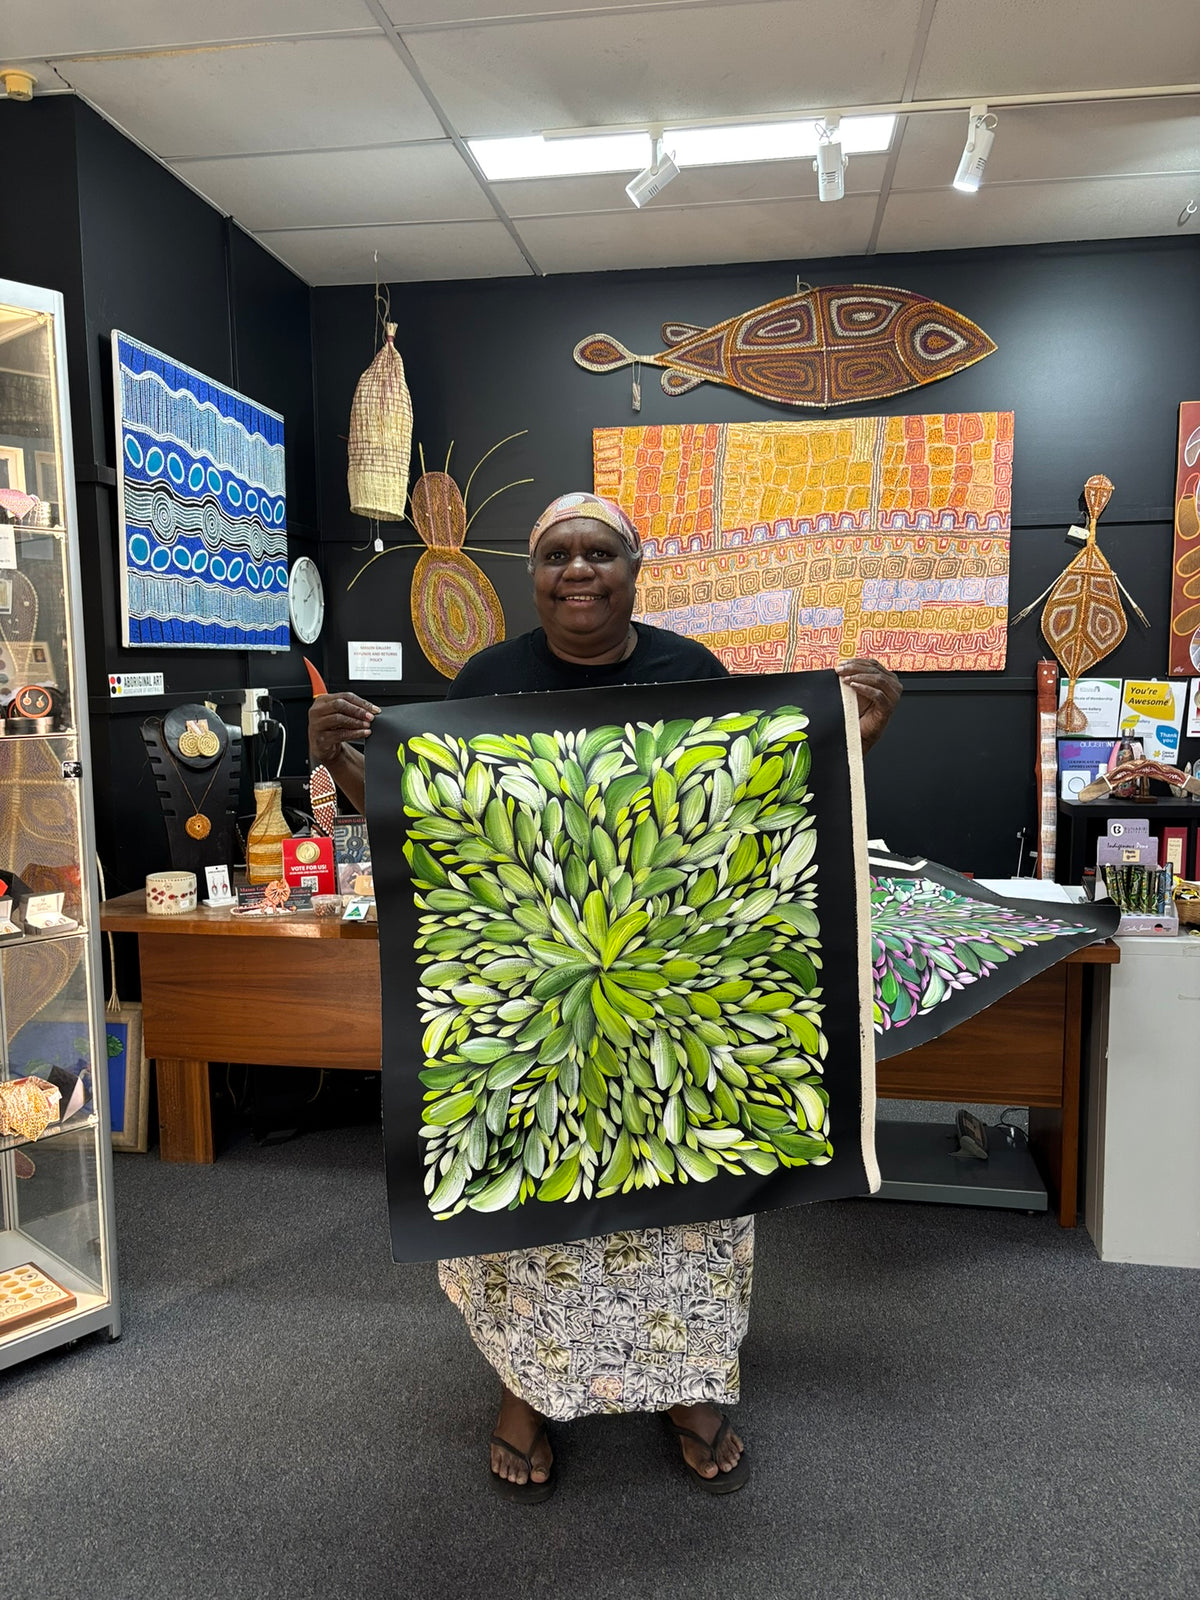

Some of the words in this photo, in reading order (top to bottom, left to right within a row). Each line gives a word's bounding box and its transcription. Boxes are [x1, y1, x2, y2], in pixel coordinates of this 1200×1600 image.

[124, 676, 152, 688] ABORIGINAL
[153, 675, 162, 686] ART
[1130, 687, 1158, 696] You're
[1128, 698, 1170, 707] Awesome
